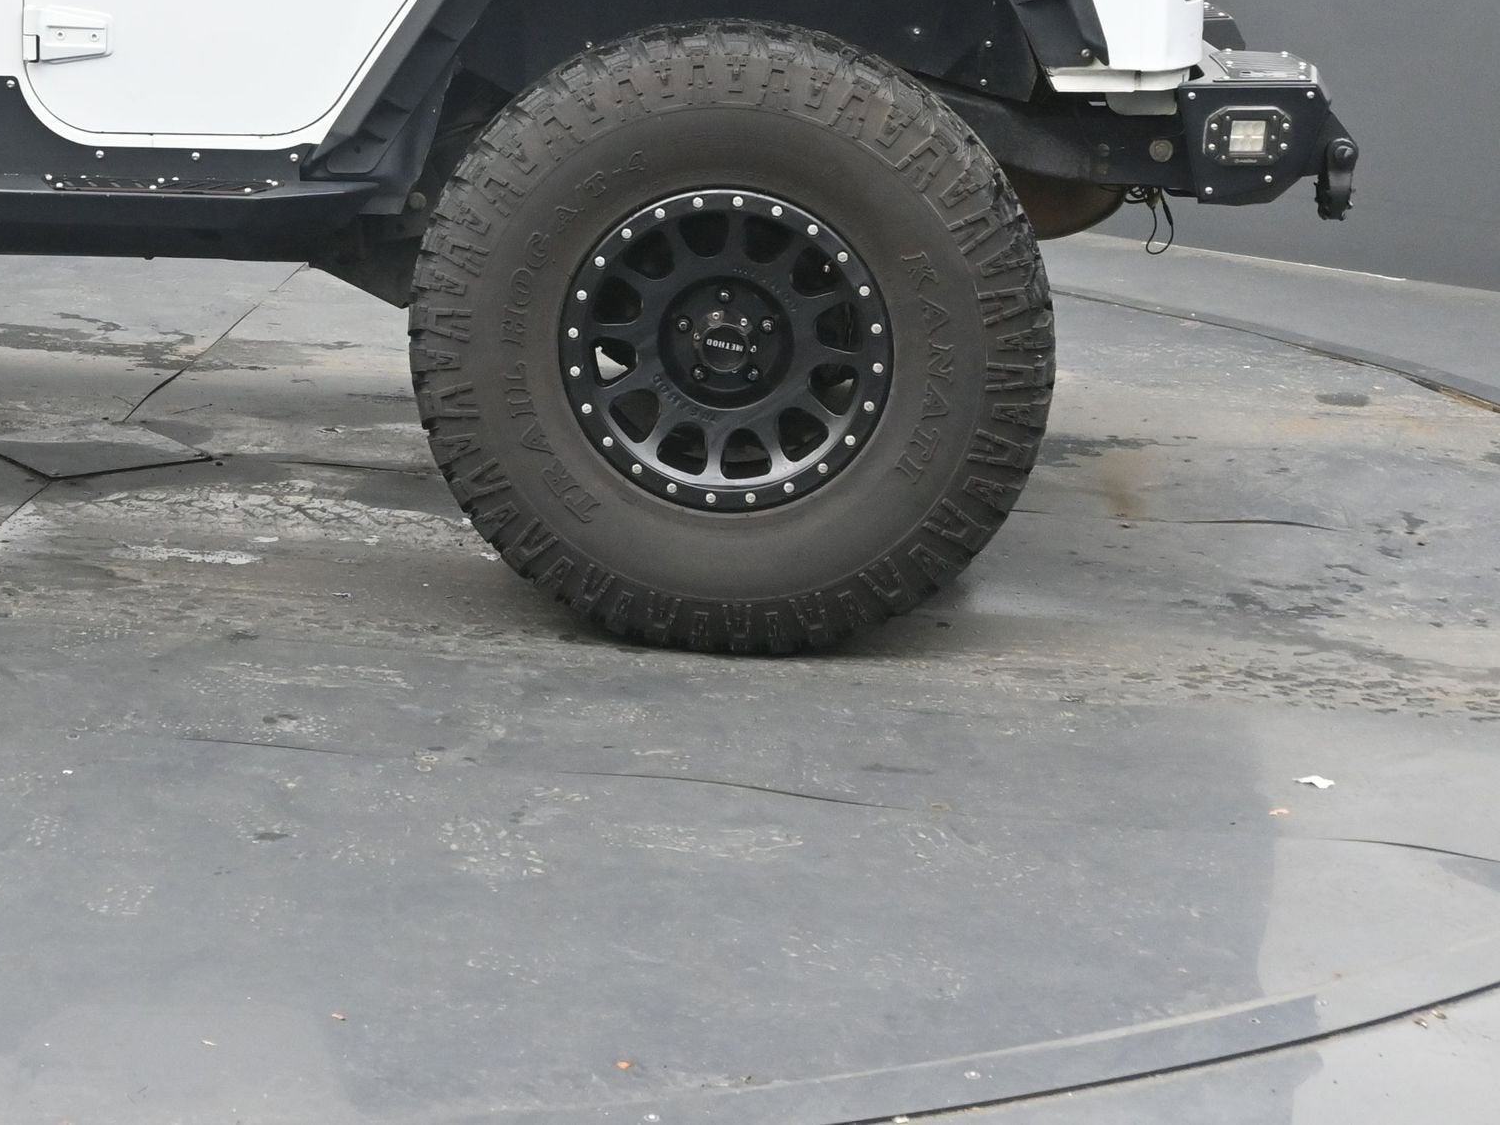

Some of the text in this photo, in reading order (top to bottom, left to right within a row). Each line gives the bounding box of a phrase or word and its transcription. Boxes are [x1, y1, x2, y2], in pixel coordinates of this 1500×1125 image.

[502, 231, 551, 349] HOG
[706, 338, 744, 352] METHOD
[895, 251, 955, 485] KANATI
[502, 360, 601, 523] TRAIL
